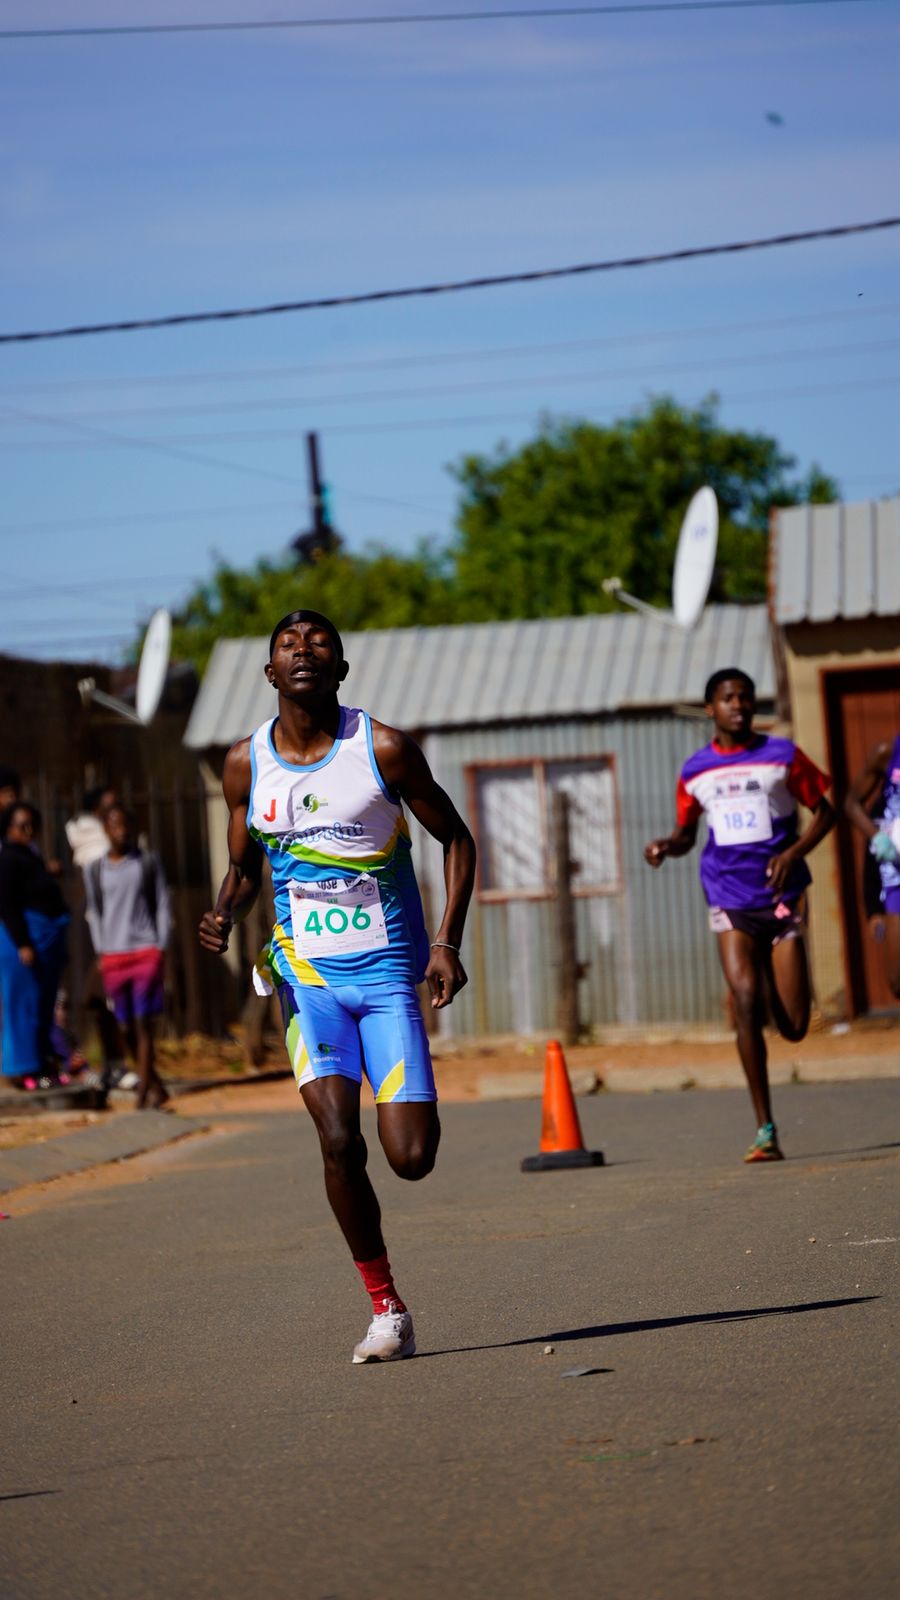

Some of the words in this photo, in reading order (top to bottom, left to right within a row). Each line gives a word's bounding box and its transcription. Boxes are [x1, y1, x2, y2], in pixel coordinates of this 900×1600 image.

[263, 799, 277, 822] J
[724, 811, 758, 831] 182
[304, 904, 371, 937] 406
